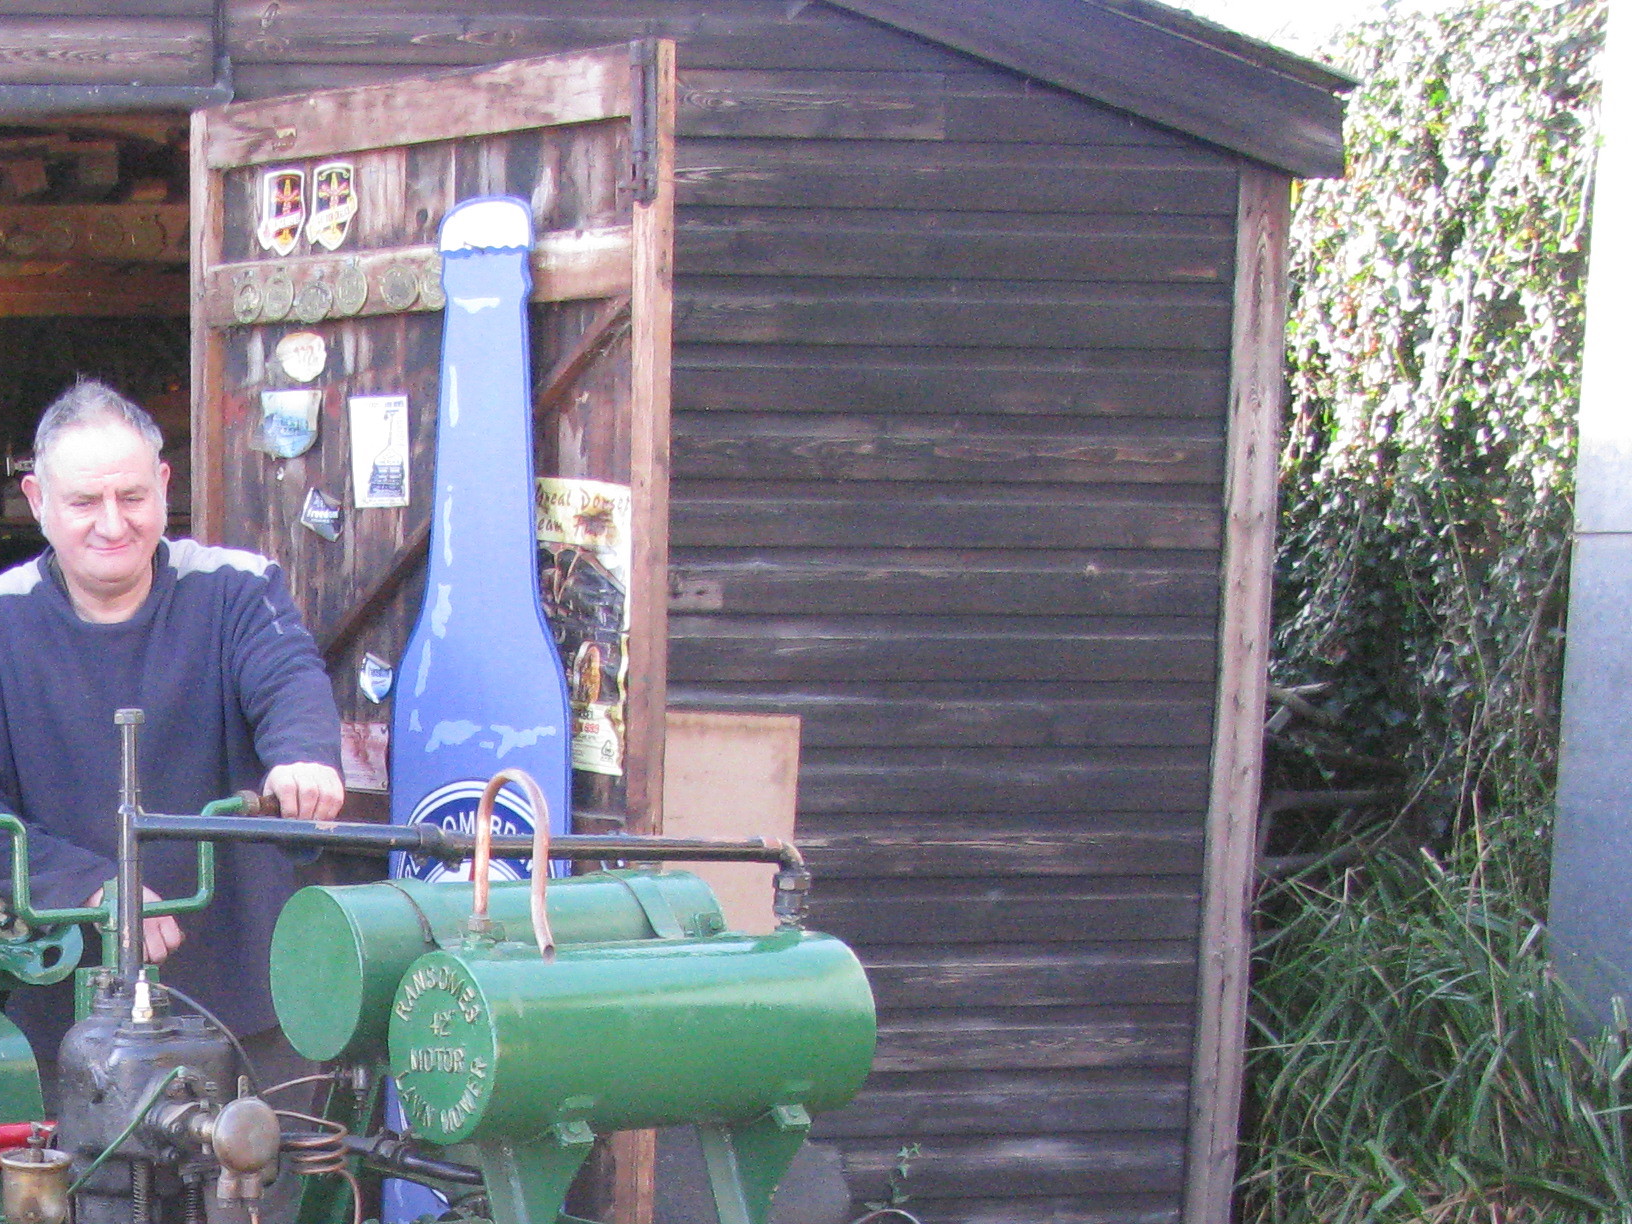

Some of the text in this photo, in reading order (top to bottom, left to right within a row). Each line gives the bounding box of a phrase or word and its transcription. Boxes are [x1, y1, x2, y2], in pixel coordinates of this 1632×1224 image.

[395, 965, 481, 1024] RANSOMES
[409, 1047, 467, 1074] MOTOR
[440, 1056, 488, 1135] MOWER
